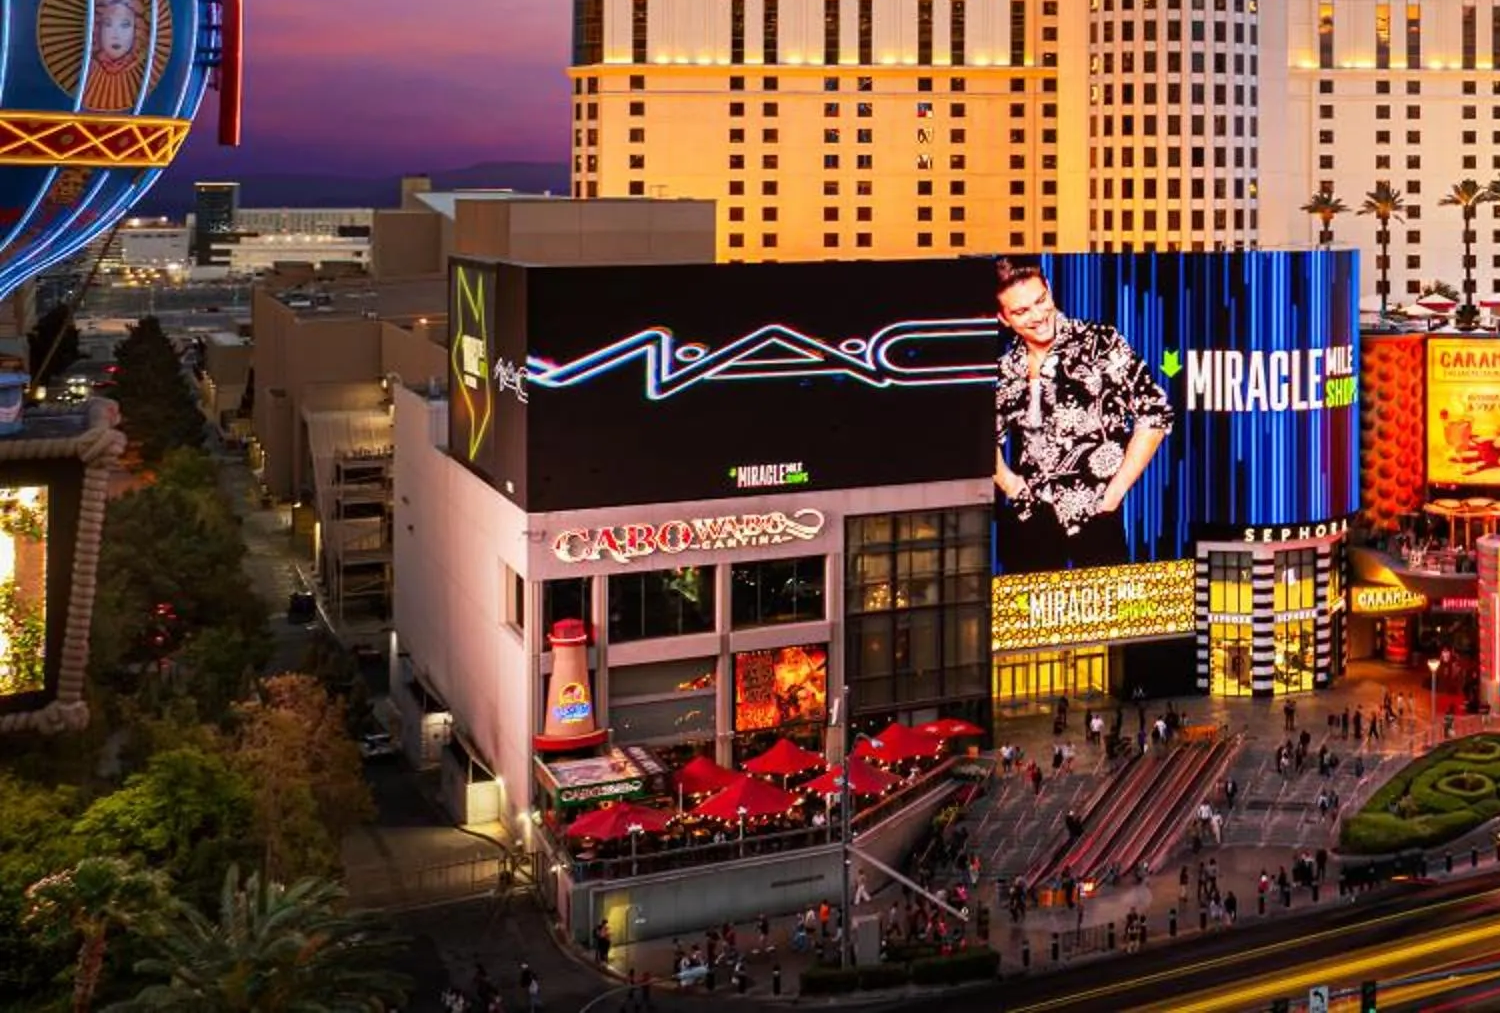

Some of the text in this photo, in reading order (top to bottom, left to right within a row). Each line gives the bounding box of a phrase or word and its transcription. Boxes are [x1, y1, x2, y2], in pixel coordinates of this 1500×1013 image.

[1186, 345, 1354, 413] MIRACLE MILE
[737, 464, 786, 487] MIRACLE
[552, 511, 788, 564] CABO WABO
[701, 536, 784, 551] CANTINA
[1244, 518, 1348, 543] SEPHORA
[1030, 586, 1116, 628] MIRACLE
